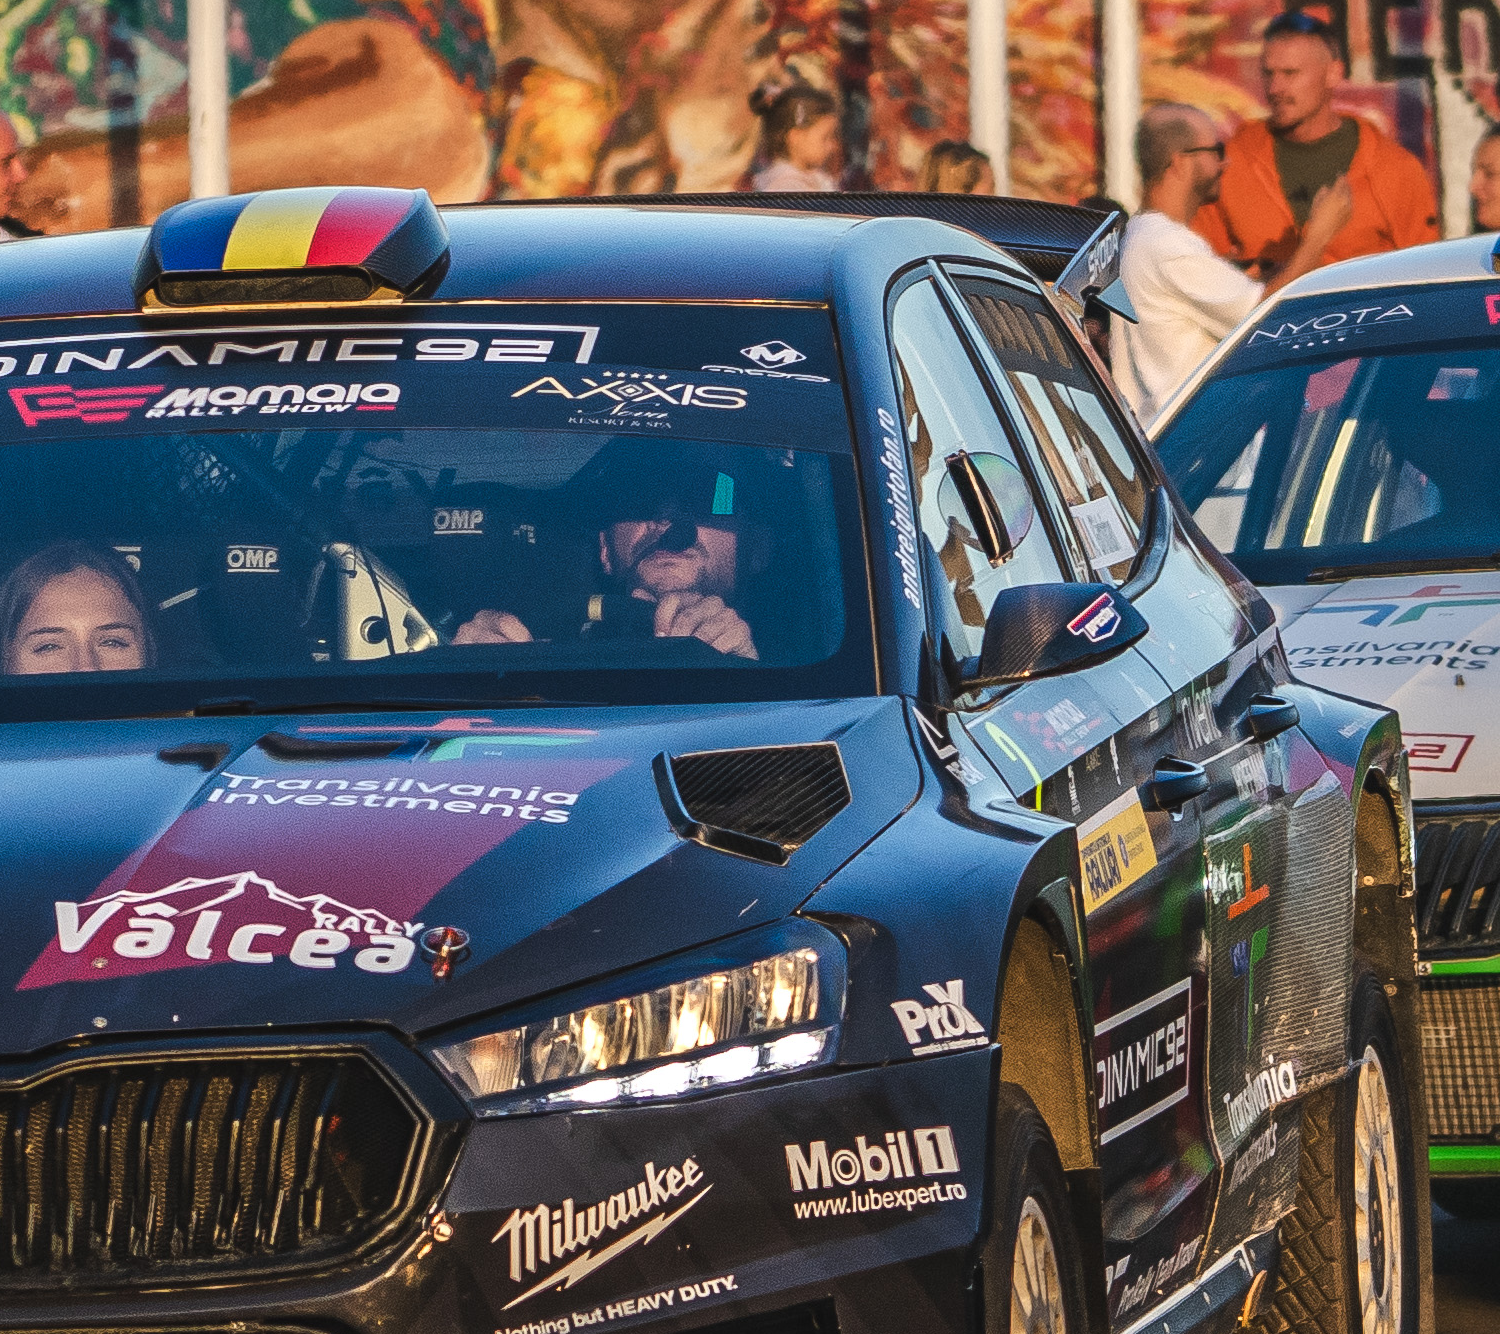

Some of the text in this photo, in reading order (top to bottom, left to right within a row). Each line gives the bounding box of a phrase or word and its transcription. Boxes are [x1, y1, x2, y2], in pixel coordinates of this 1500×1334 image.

[1248, 304, 1414, 345] NYOTA
[145, 403, 354, 419] RALLY SHOW
[152, 382, 401, 408] Mamaia
[433, 510, 484, 532] OMP
[877, 407, 922, 610] andreigirtofan.ro
[226, 548, 279, 570] OMP
[1287, 639, 1500, 657] nsilvania
[206, 787, 572, 824] Investments
[218, 770, 580, 808] Transilvania
[54, 899, 417, 974] Vâlcea
[311, 912, 425, 937] RALLY
[1096, 1015, 1187, 1109] DINAMIC92
[784, 1130, 915, 1193] Mobil
[490, 1154, 704, 1283] Milwaukee
[794, 1180, 968, 1220] www.lubexpert.ro
[573, 1307, 605, 1330] but
[606, 1289, 676, 1321] HEAVY
